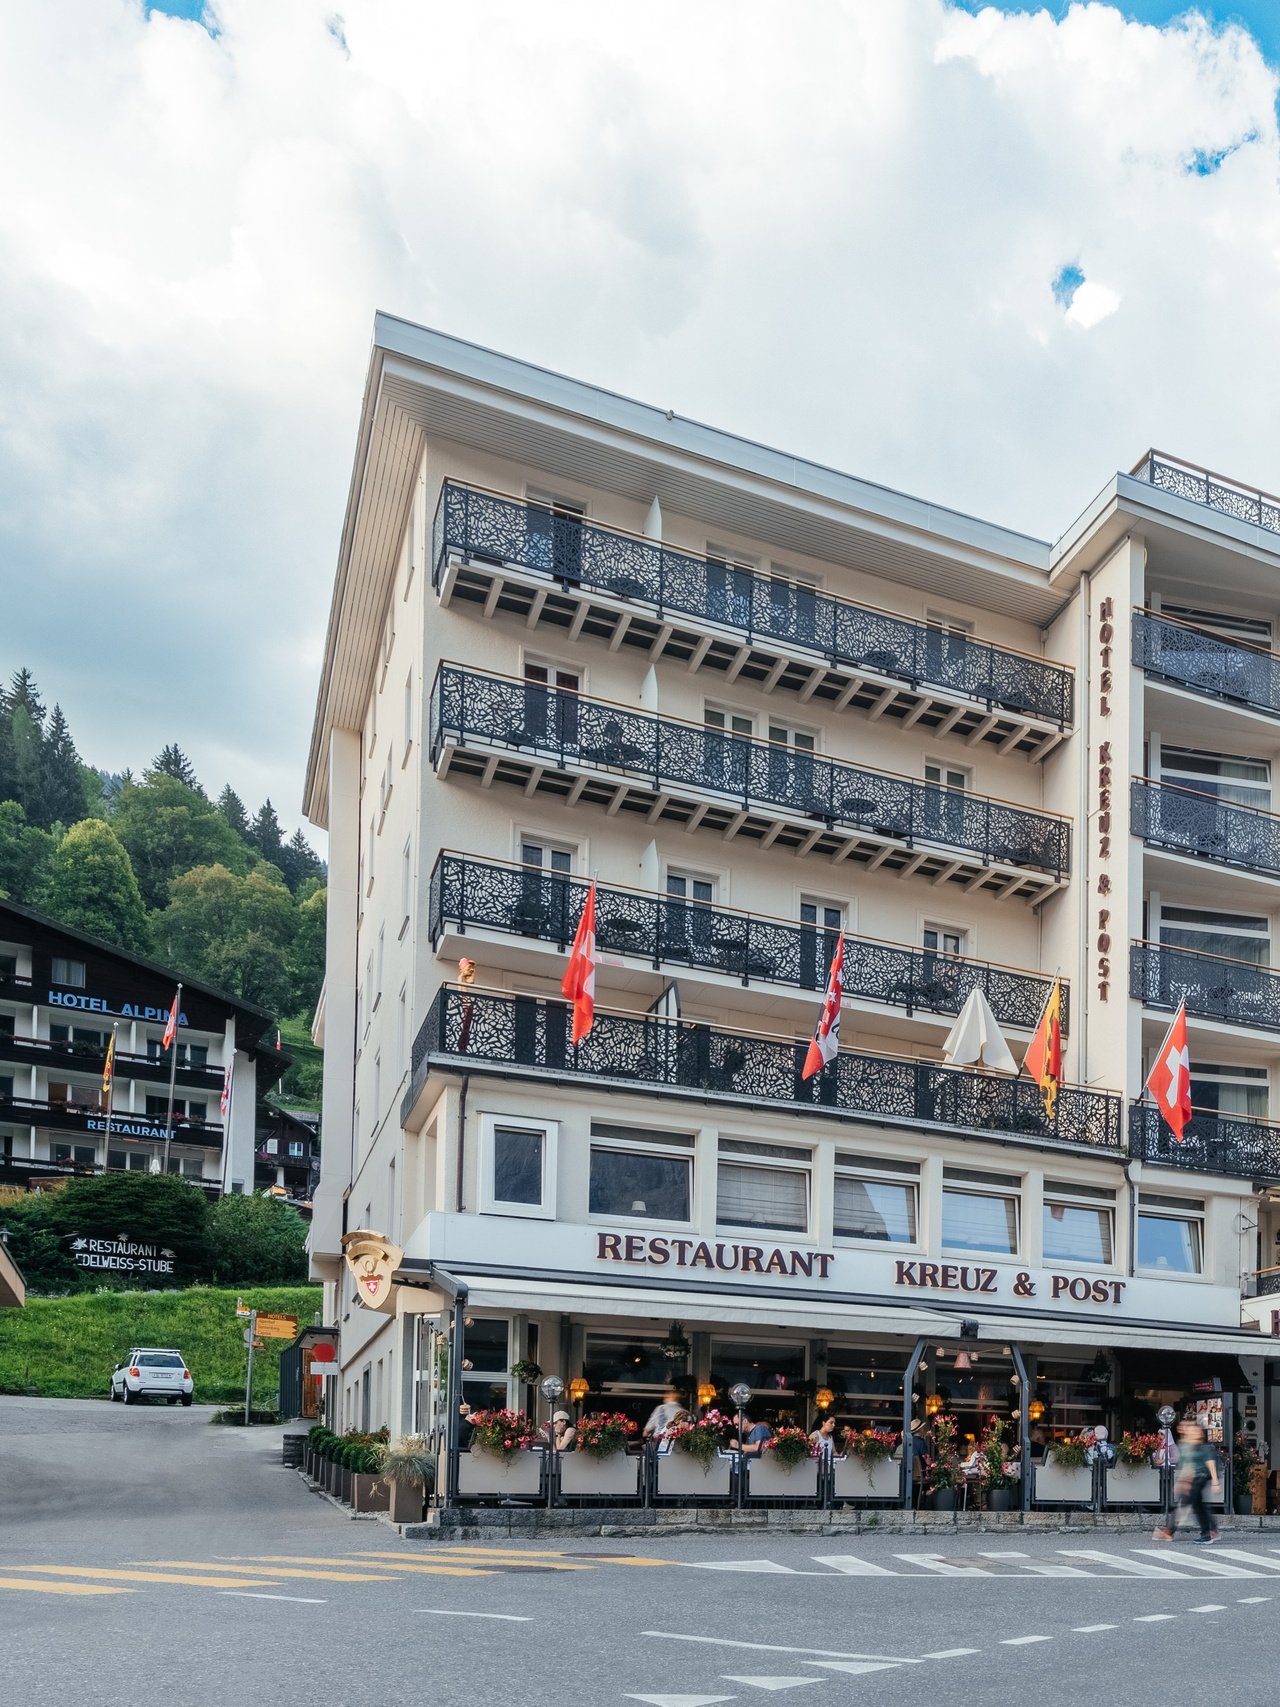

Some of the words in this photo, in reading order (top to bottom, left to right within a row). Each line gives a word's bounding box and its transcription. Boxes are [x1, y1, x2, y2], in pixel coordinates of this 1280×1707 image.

[1098, 596, 1112, 718] HOTEL
[1098, 741, 1112, 859] KREUZ
[1097, 873, 1112, 895] &
[1097, 908, 1112, 1003] POST
[48, 990, 113, 1013] HOTEL
[87, 1119, 176, 1139] RESTAURANT
[75, 1253, 174, 1273] EDELWEISS-STUBE
[89, 1239, 157, 1257] RESTAURANT
[597, 1232, 835, 1278] RESTAURANT
[894, 1260, 998, 1293] KREUZ
[1012, 1272, 1036, 1297] &
[1051, 1275, 1126, 1304] POST
